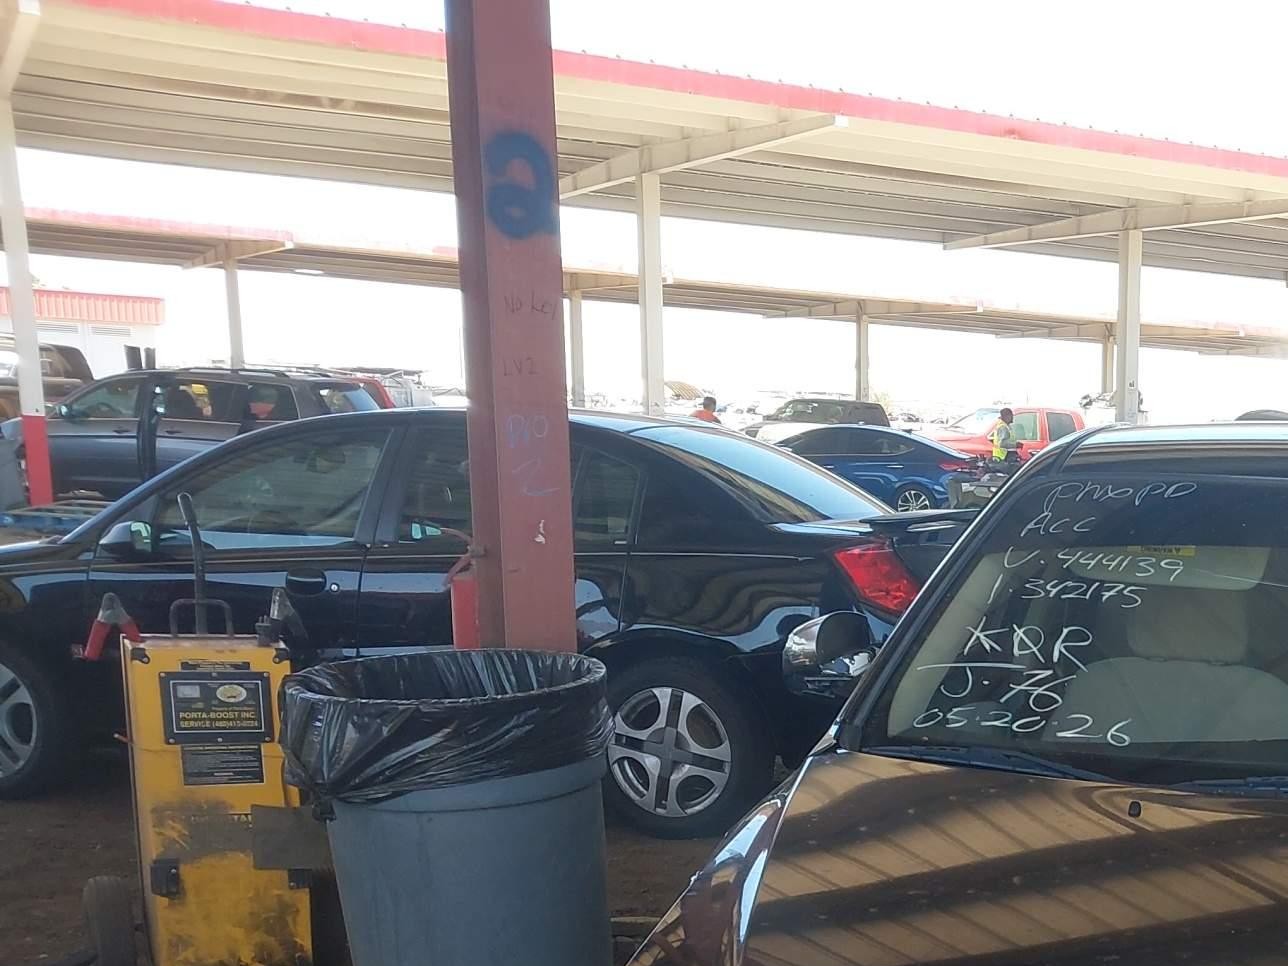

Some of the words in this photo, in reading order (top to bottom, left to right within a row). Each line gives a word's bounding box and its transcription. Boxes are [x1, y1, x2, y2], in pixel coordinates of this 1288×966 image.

[1056, 548, 1185, 582] 444139
[1020, 578, 1148, 608] 342175
[179, 711, 239, 719] PORTA-BOOST
[180, 720, 211, 728] SERVICE
